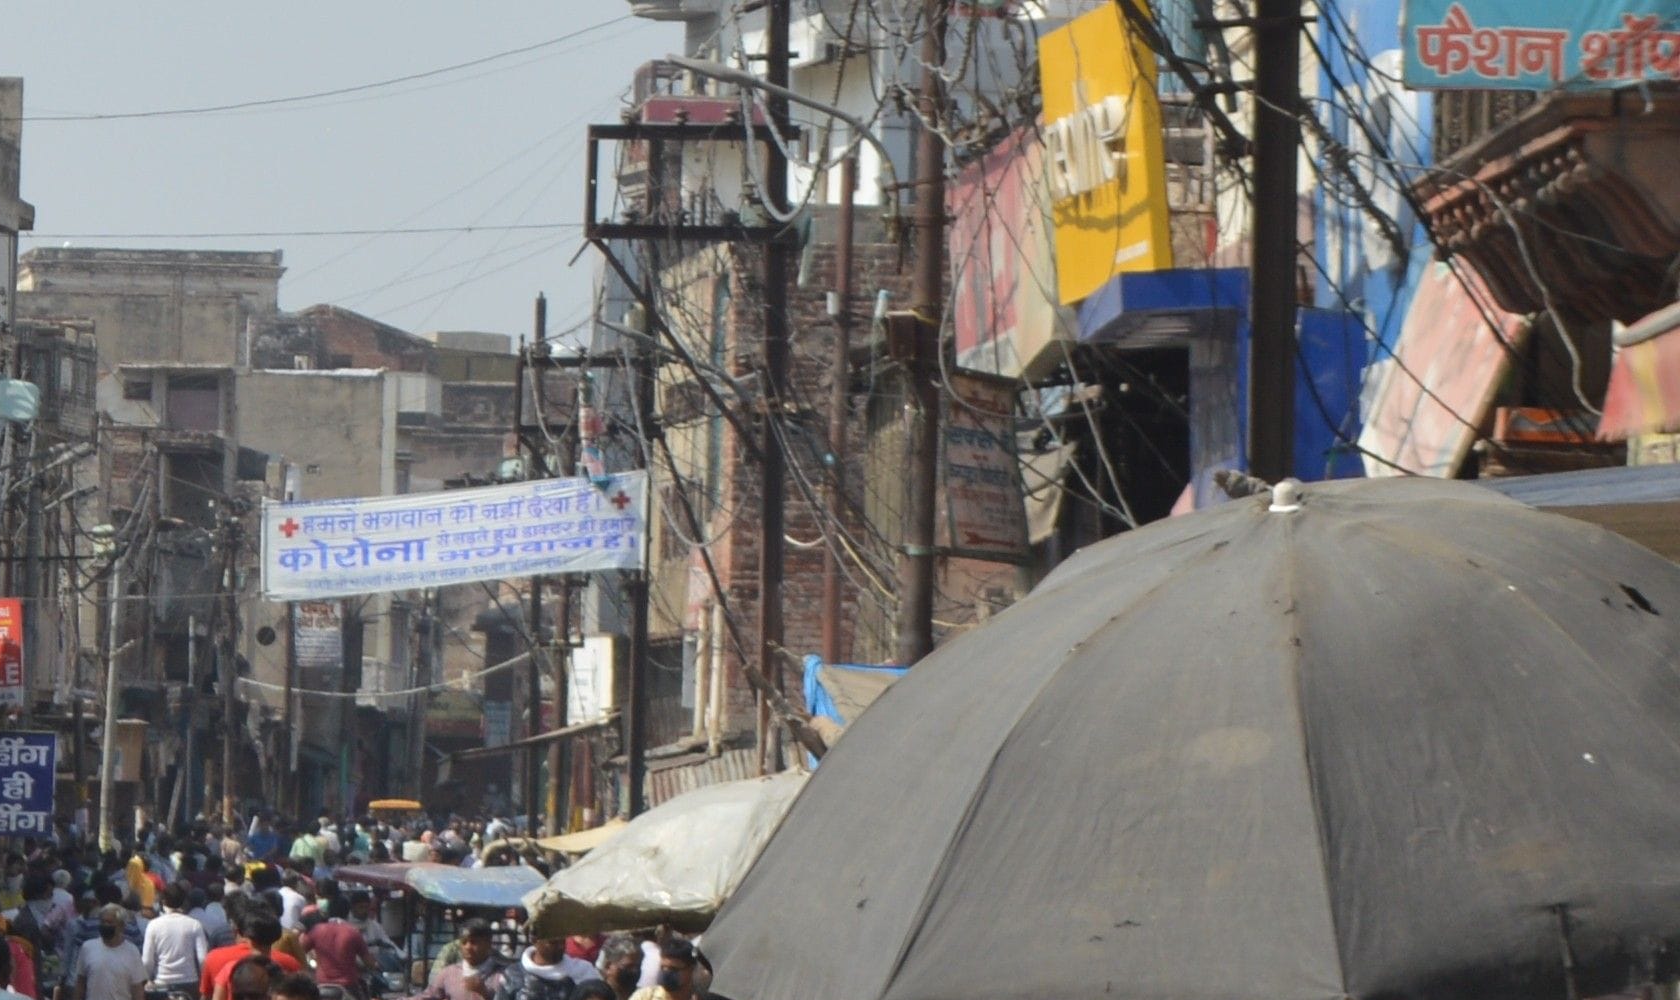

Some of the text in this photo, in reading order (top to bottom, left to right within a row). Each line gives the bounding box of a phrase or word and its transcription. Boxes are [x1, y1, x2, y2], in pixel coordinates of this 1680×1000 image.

[1416, 3, 1568, 81] फैशन
[303, 509, 359, 535] हमने
[363, 507, 444, 530] भगवान
[481, 495, 525, 520] नहीं
[528, 496, 572, 518] देखा
[279, 537, 431, 572] कोरोना
[2, 771, 34, 800] ही
